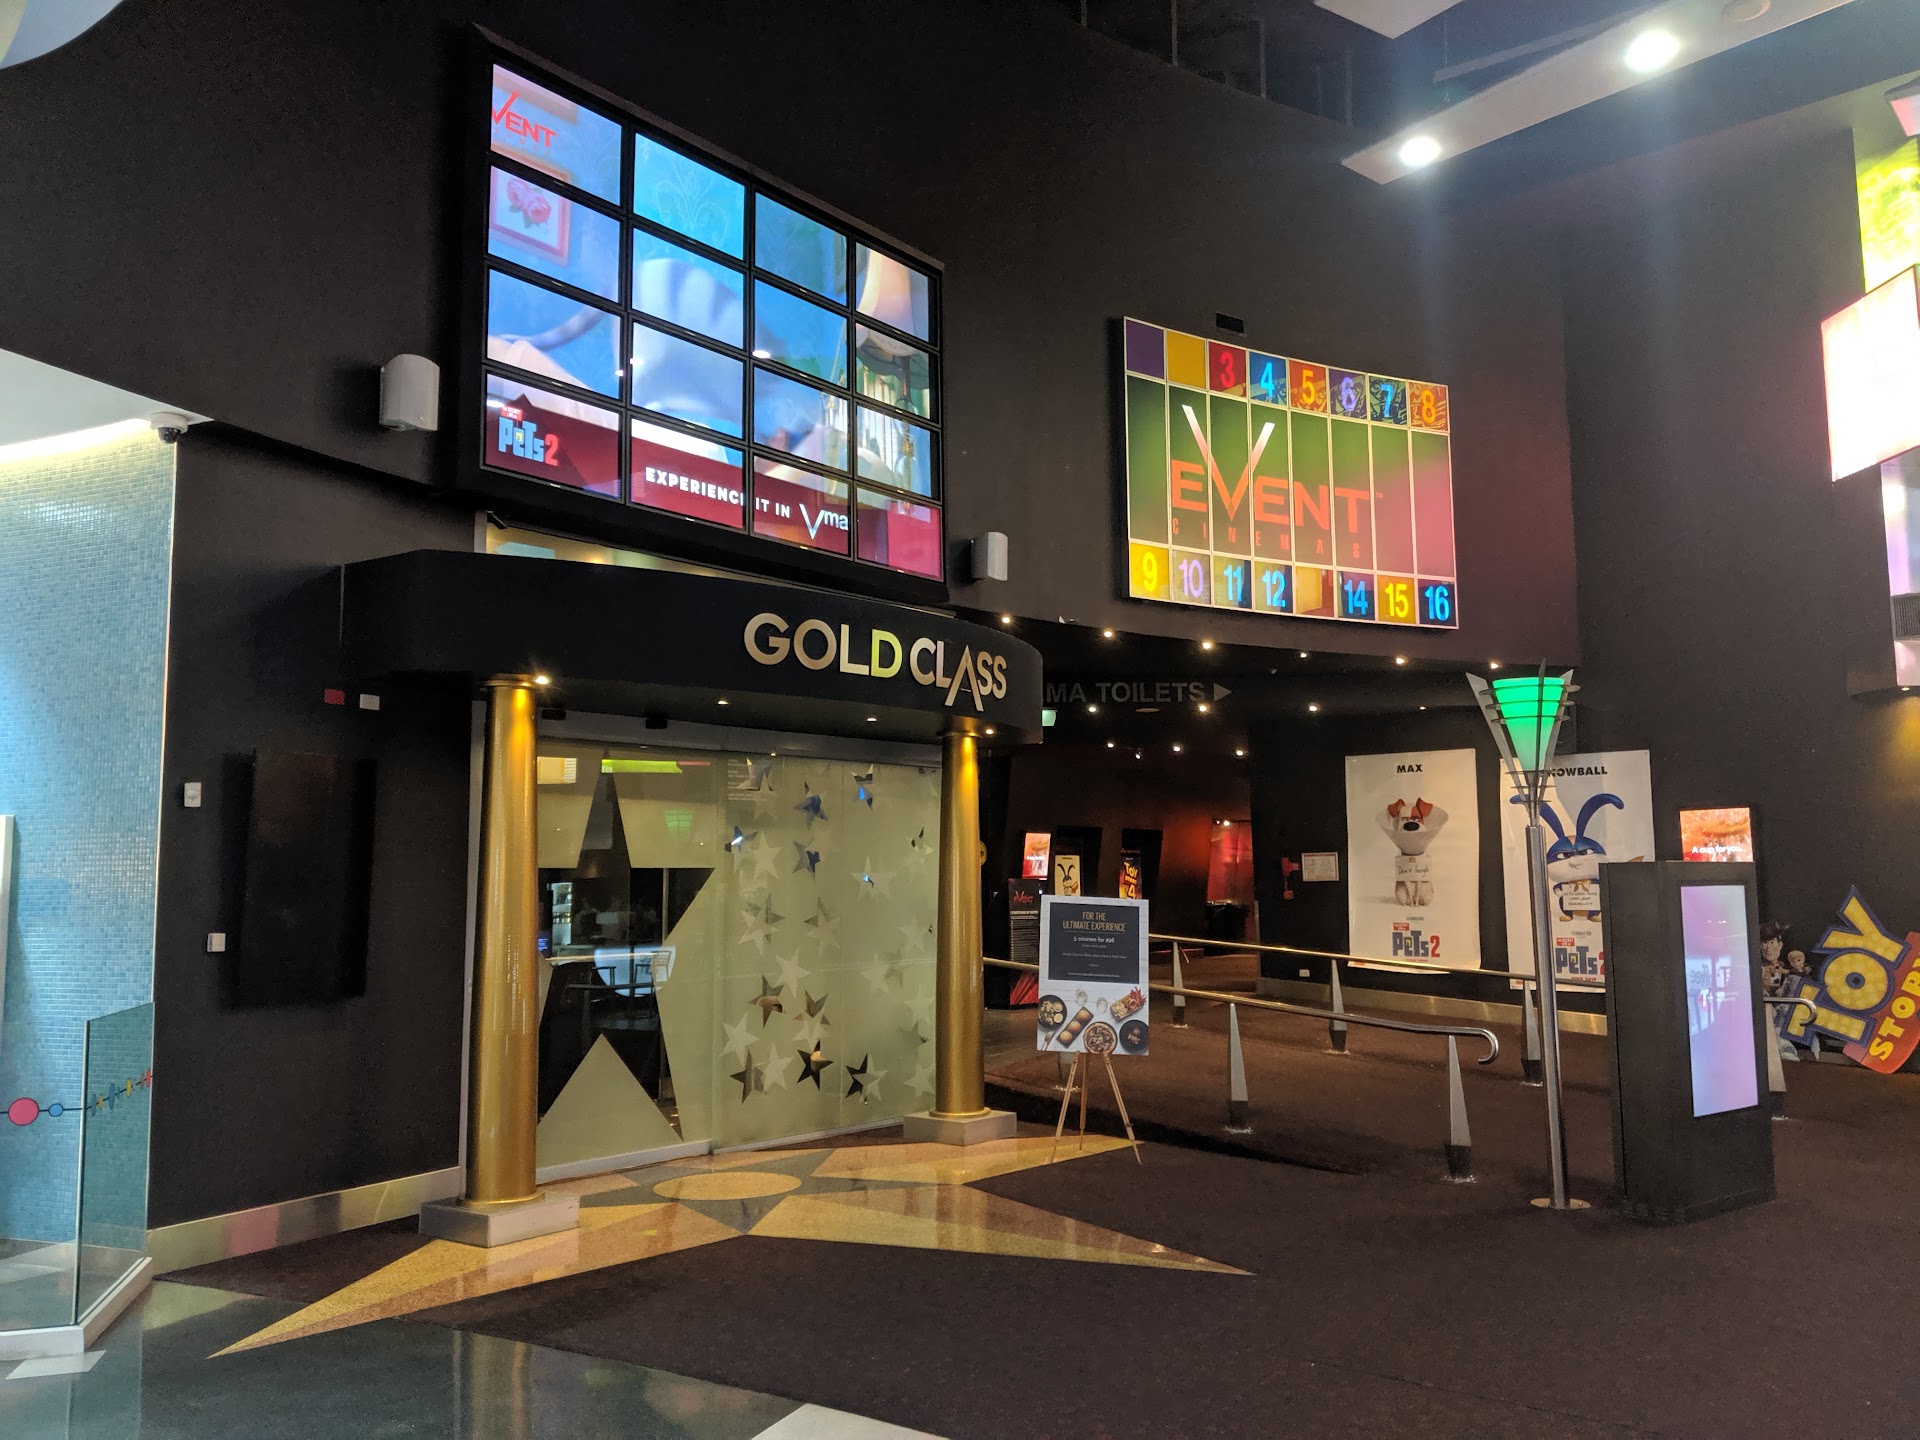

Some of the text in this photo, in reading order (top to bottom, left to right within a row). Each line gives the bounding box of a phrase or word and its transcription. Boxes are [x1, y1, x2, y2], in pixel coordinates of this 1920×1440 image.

[1220, 352, 1437, 424] 3 4 5 6 7 8
[545, 433, 559, 467] 2
[1171, 404, 1370, 534] EVENT
[756, 497, 770, 513] IT
[775, 502, 790, 518] IN
[1172, 517, 1360, 559] CINEMAS
[1142, 551, 1450, 621] 9 10 11 12 14 15 16
[743, 612, 1008, 712] GOLD CLASS
[1042, 681, 1206, 704] MA TOILETS
[1396, 764, 1423, 774] MAX
[1062, 920, 1127, 932] ULTIMATE EXPERIENCE
[1082, 911, 1107, 921] FOR THE
[1430, 935, 1440, 958] 2
[1784, 892, 1906, 1043] TOY
[1869, 957, 1920, 1061] STOR
